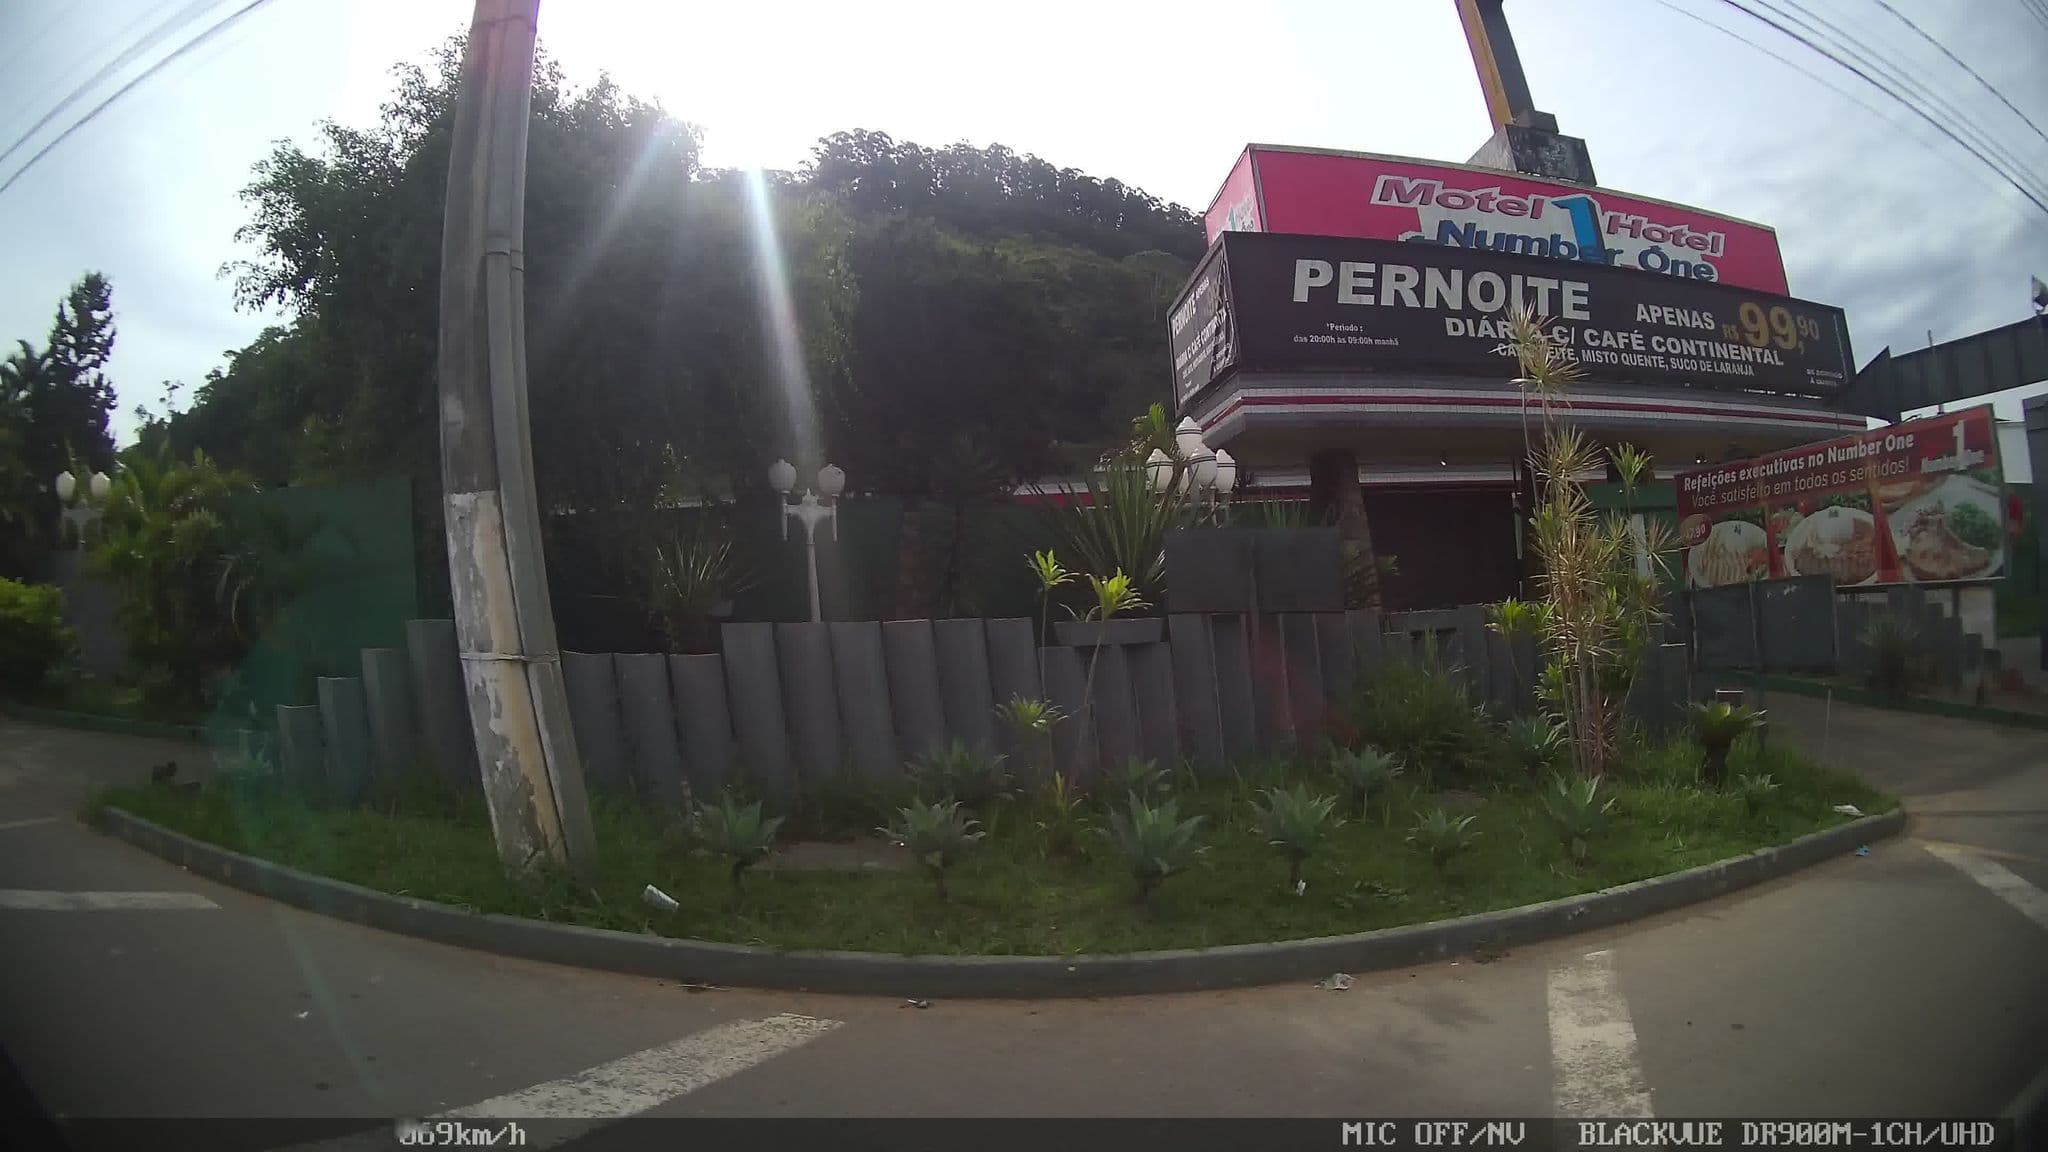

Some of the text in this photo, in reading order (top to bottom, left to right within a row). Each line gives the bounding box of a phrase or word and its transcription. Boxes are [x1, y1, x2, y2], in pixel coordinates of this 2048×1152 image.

[1379, 177, 1545, 219] Motel
[1551, 196, 1606, 263] 1
[1607, 213, 1721, 253] Hotel
[1293, 259, 1590, 321] PERNOITE
[1309, 334, 1335, 345] 20:00h
[1636, 303, 1716, 330] APENAS
[1445, 315, 1542, 342] DIÁRA
[1584, 328, 1645, 350] CAFÉ
[1652, 335, 1784, 366] CONTINENTAL
[1582, 350, 1618, 364] MISTO
[1621, 353, 1669, 371] QUENTE,
[1670, 357, 1697, 372] SUCO
[1700, 360, 1712, 372] DE
[1714, 362, 1755, 376] LARANJA
[1684, 433, 1914, 492] Refeições executivas no Number One
[1952, 420, 1967, 471] 1
[1720, 482, 1770, 503] satisfeito
[1774, 480, 1791, 494] em
[1794, 473, 1828, 492] todos
[1832, 470, 1846, 484] os
[1851, 457, 1909, 482] sentidos!
